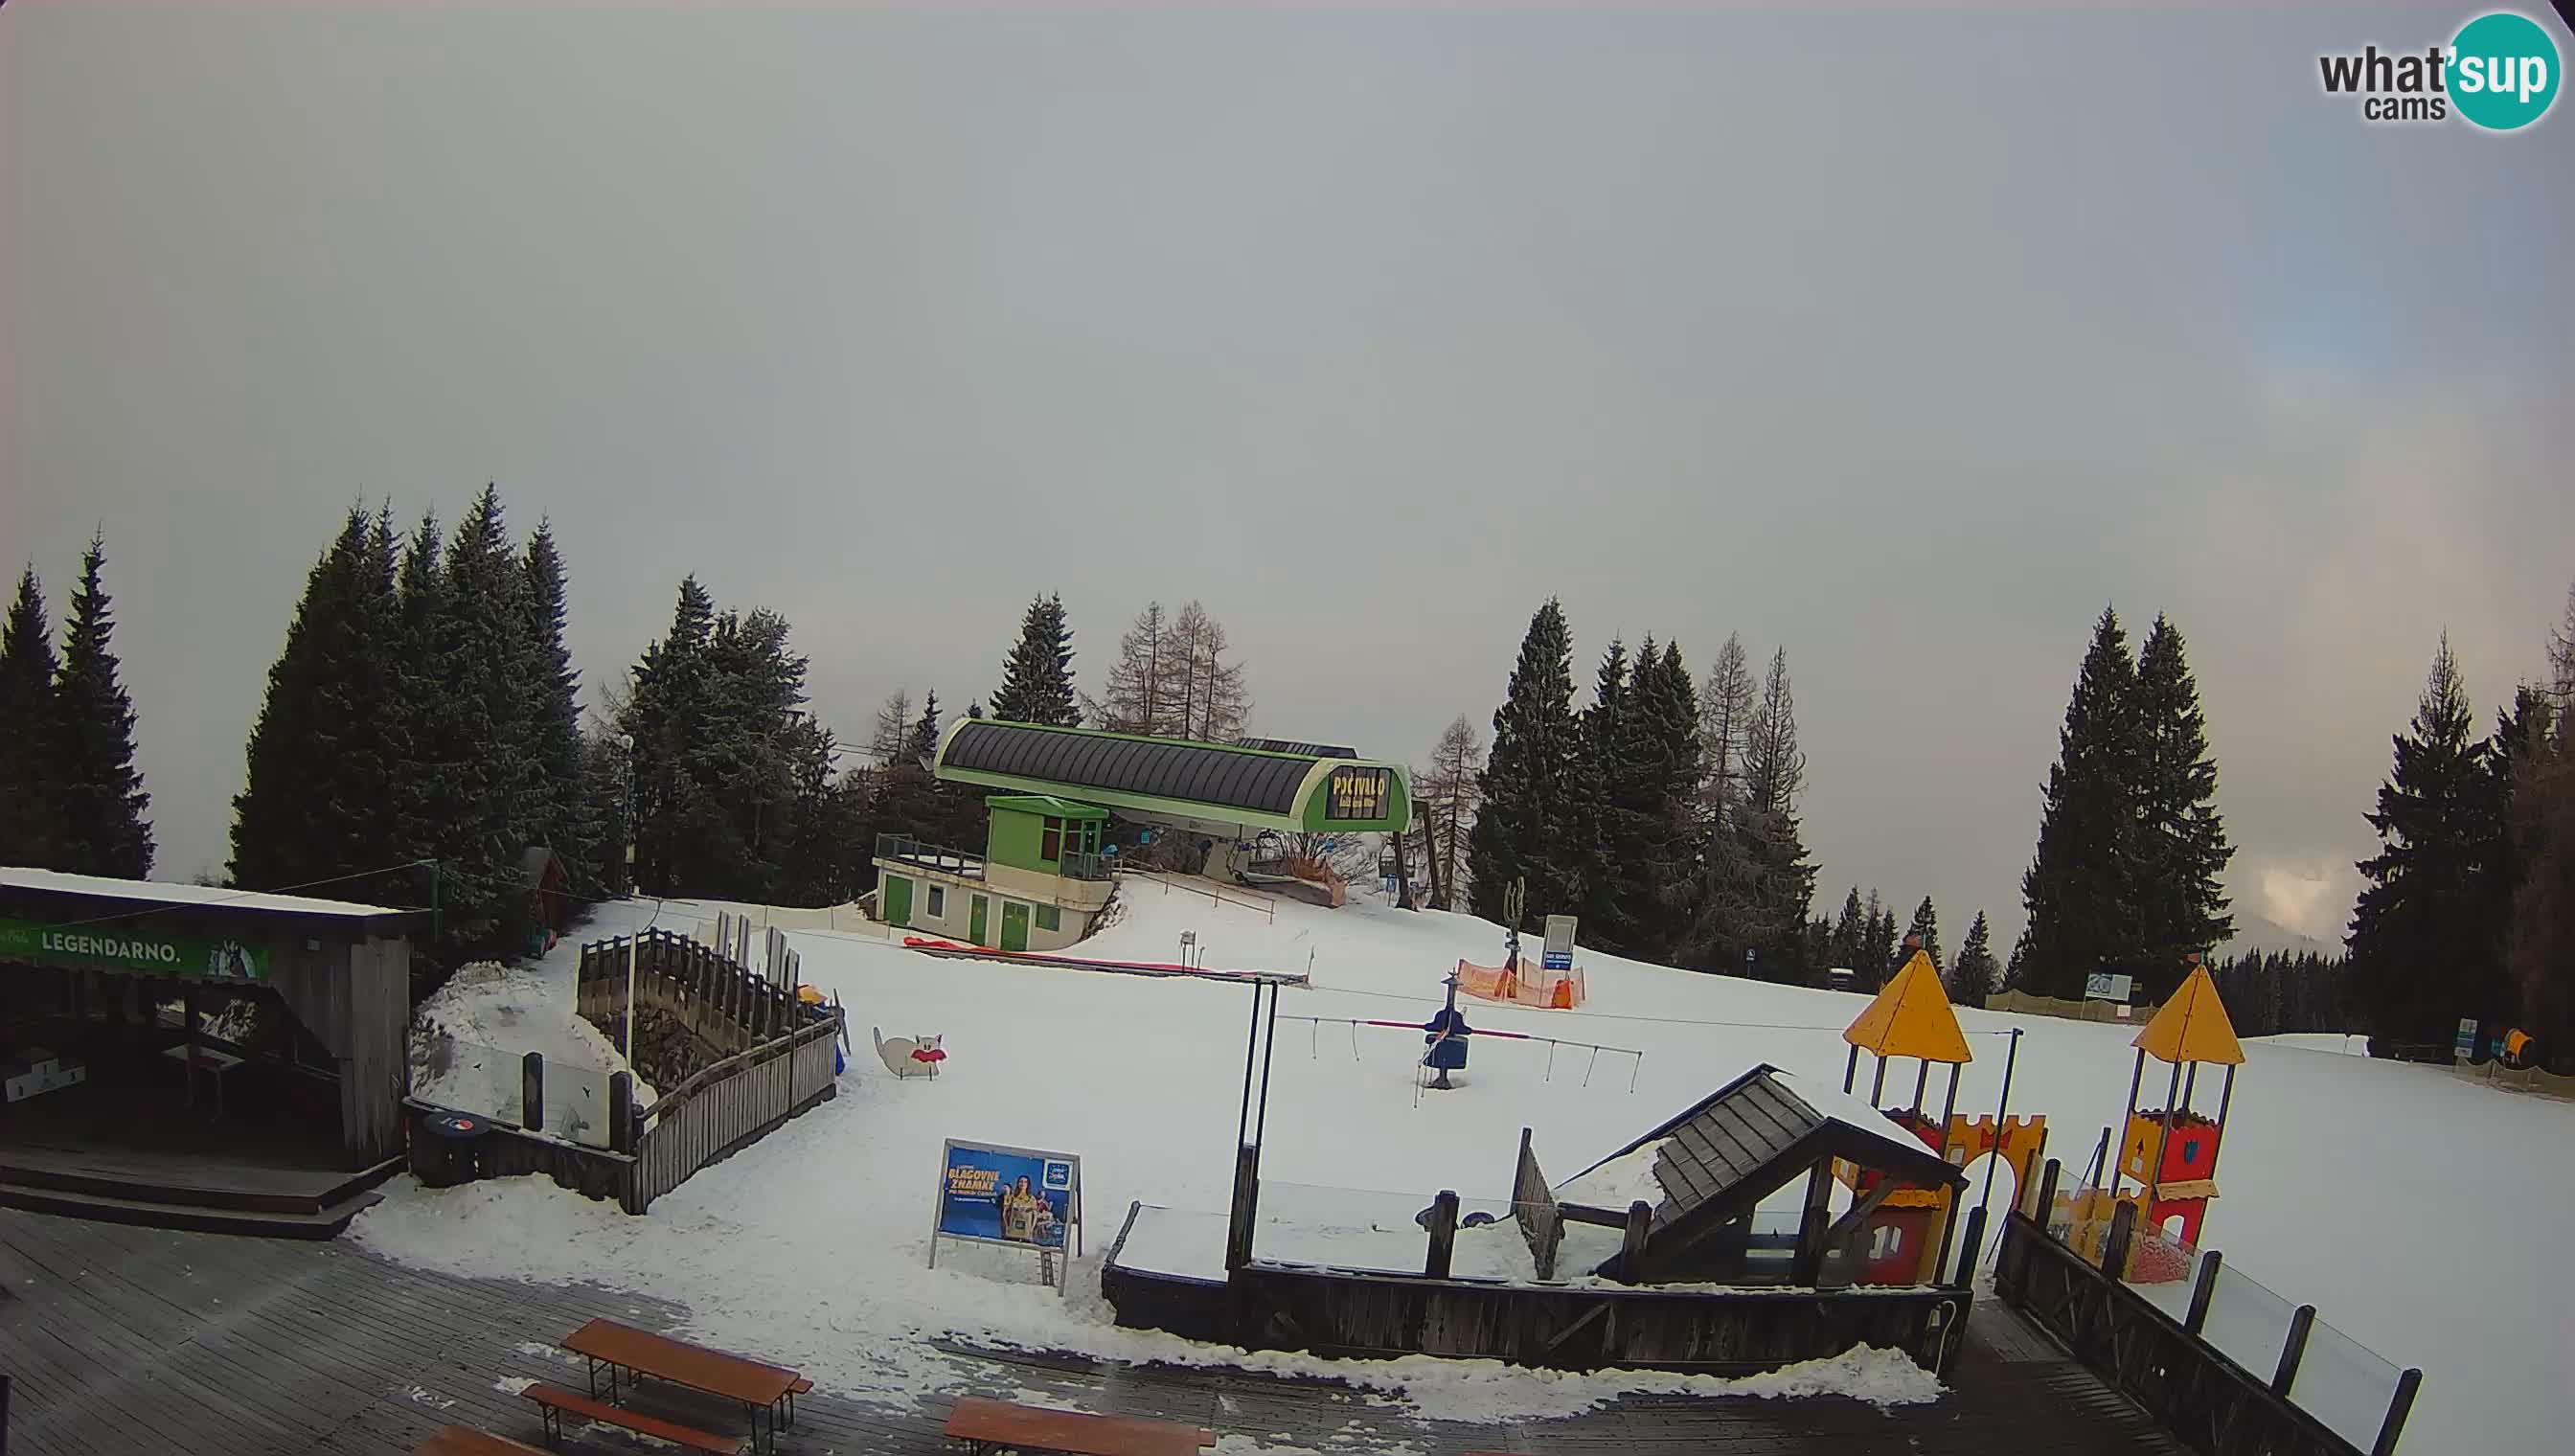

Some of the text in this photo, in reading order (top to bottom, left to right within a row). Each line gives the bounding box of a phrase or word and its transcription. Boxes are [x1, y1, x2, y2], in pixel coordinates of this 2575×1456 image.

[41, 931, 181, 963] LEGENDARNO.
[948, 1168, 1000, 1181] BLAGOVNE
[950, 1179, 995, 1192] ZNAMKE
